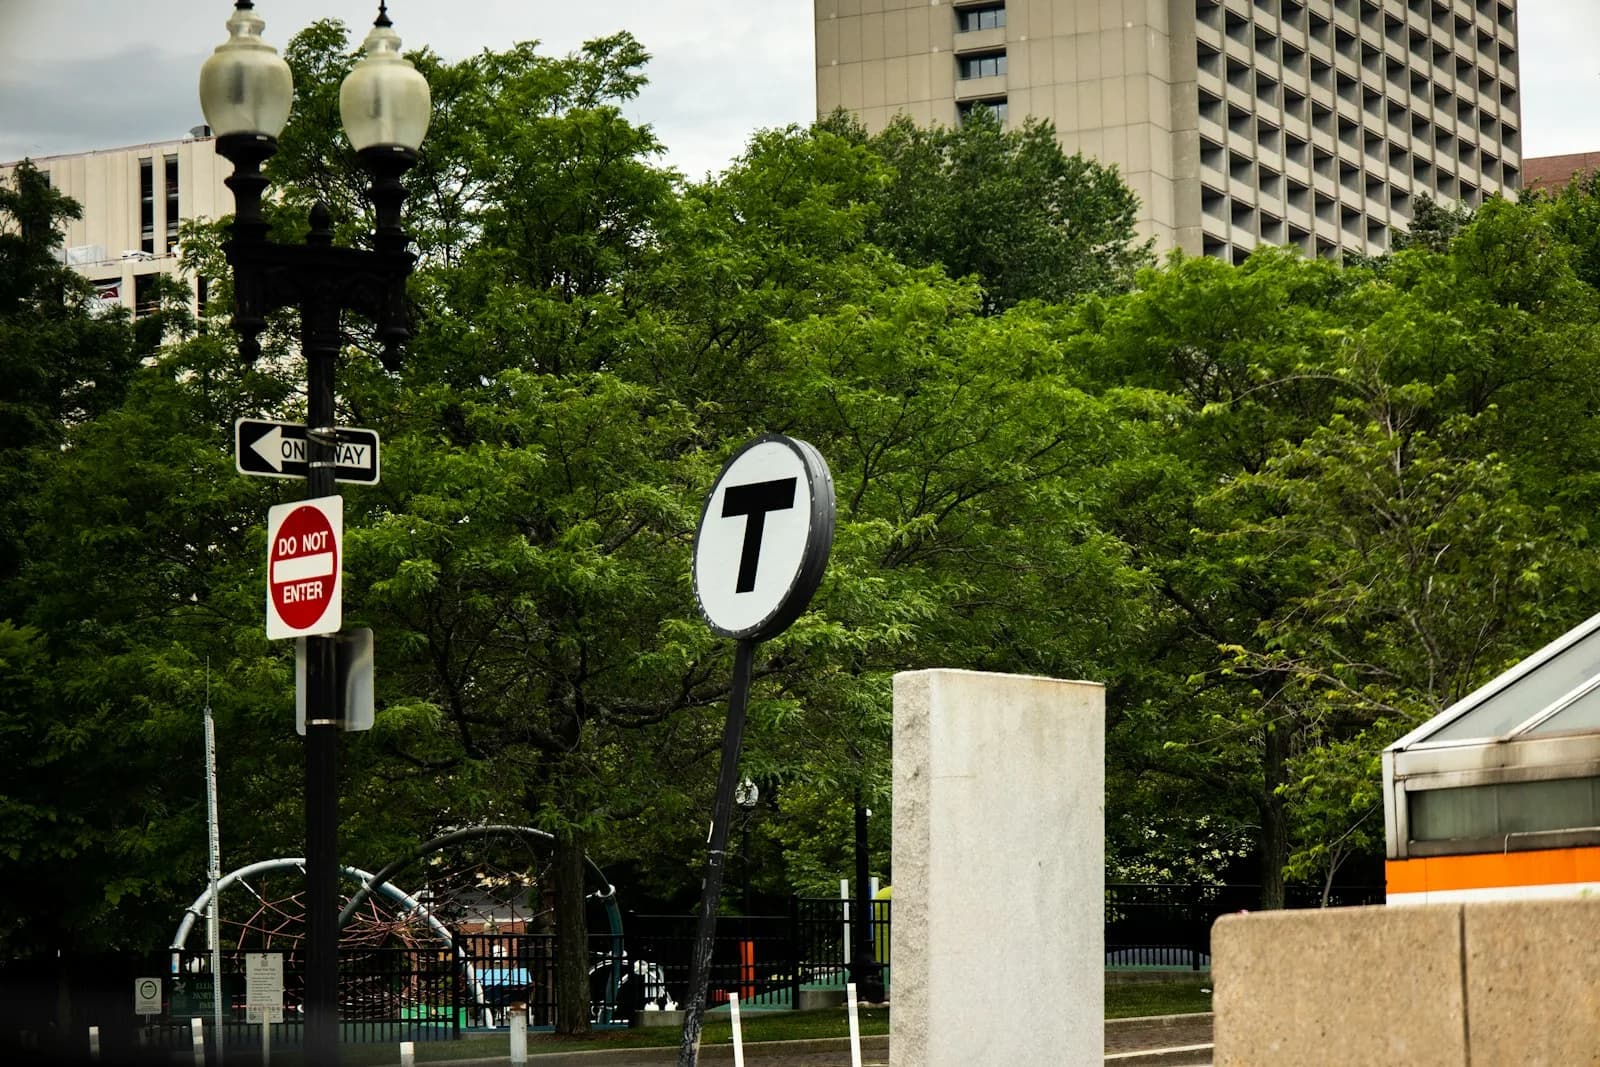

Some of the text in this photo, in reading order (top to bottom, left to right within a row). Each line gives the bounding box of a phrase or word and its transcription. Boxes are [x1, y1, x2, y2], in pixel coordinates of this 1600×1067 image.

[281, 440, 305, 460] ON
[278, 531, 328, 556] DO NOT
[721, 477, 797, 593] T
[283, 581, 323, 604] ENTER
